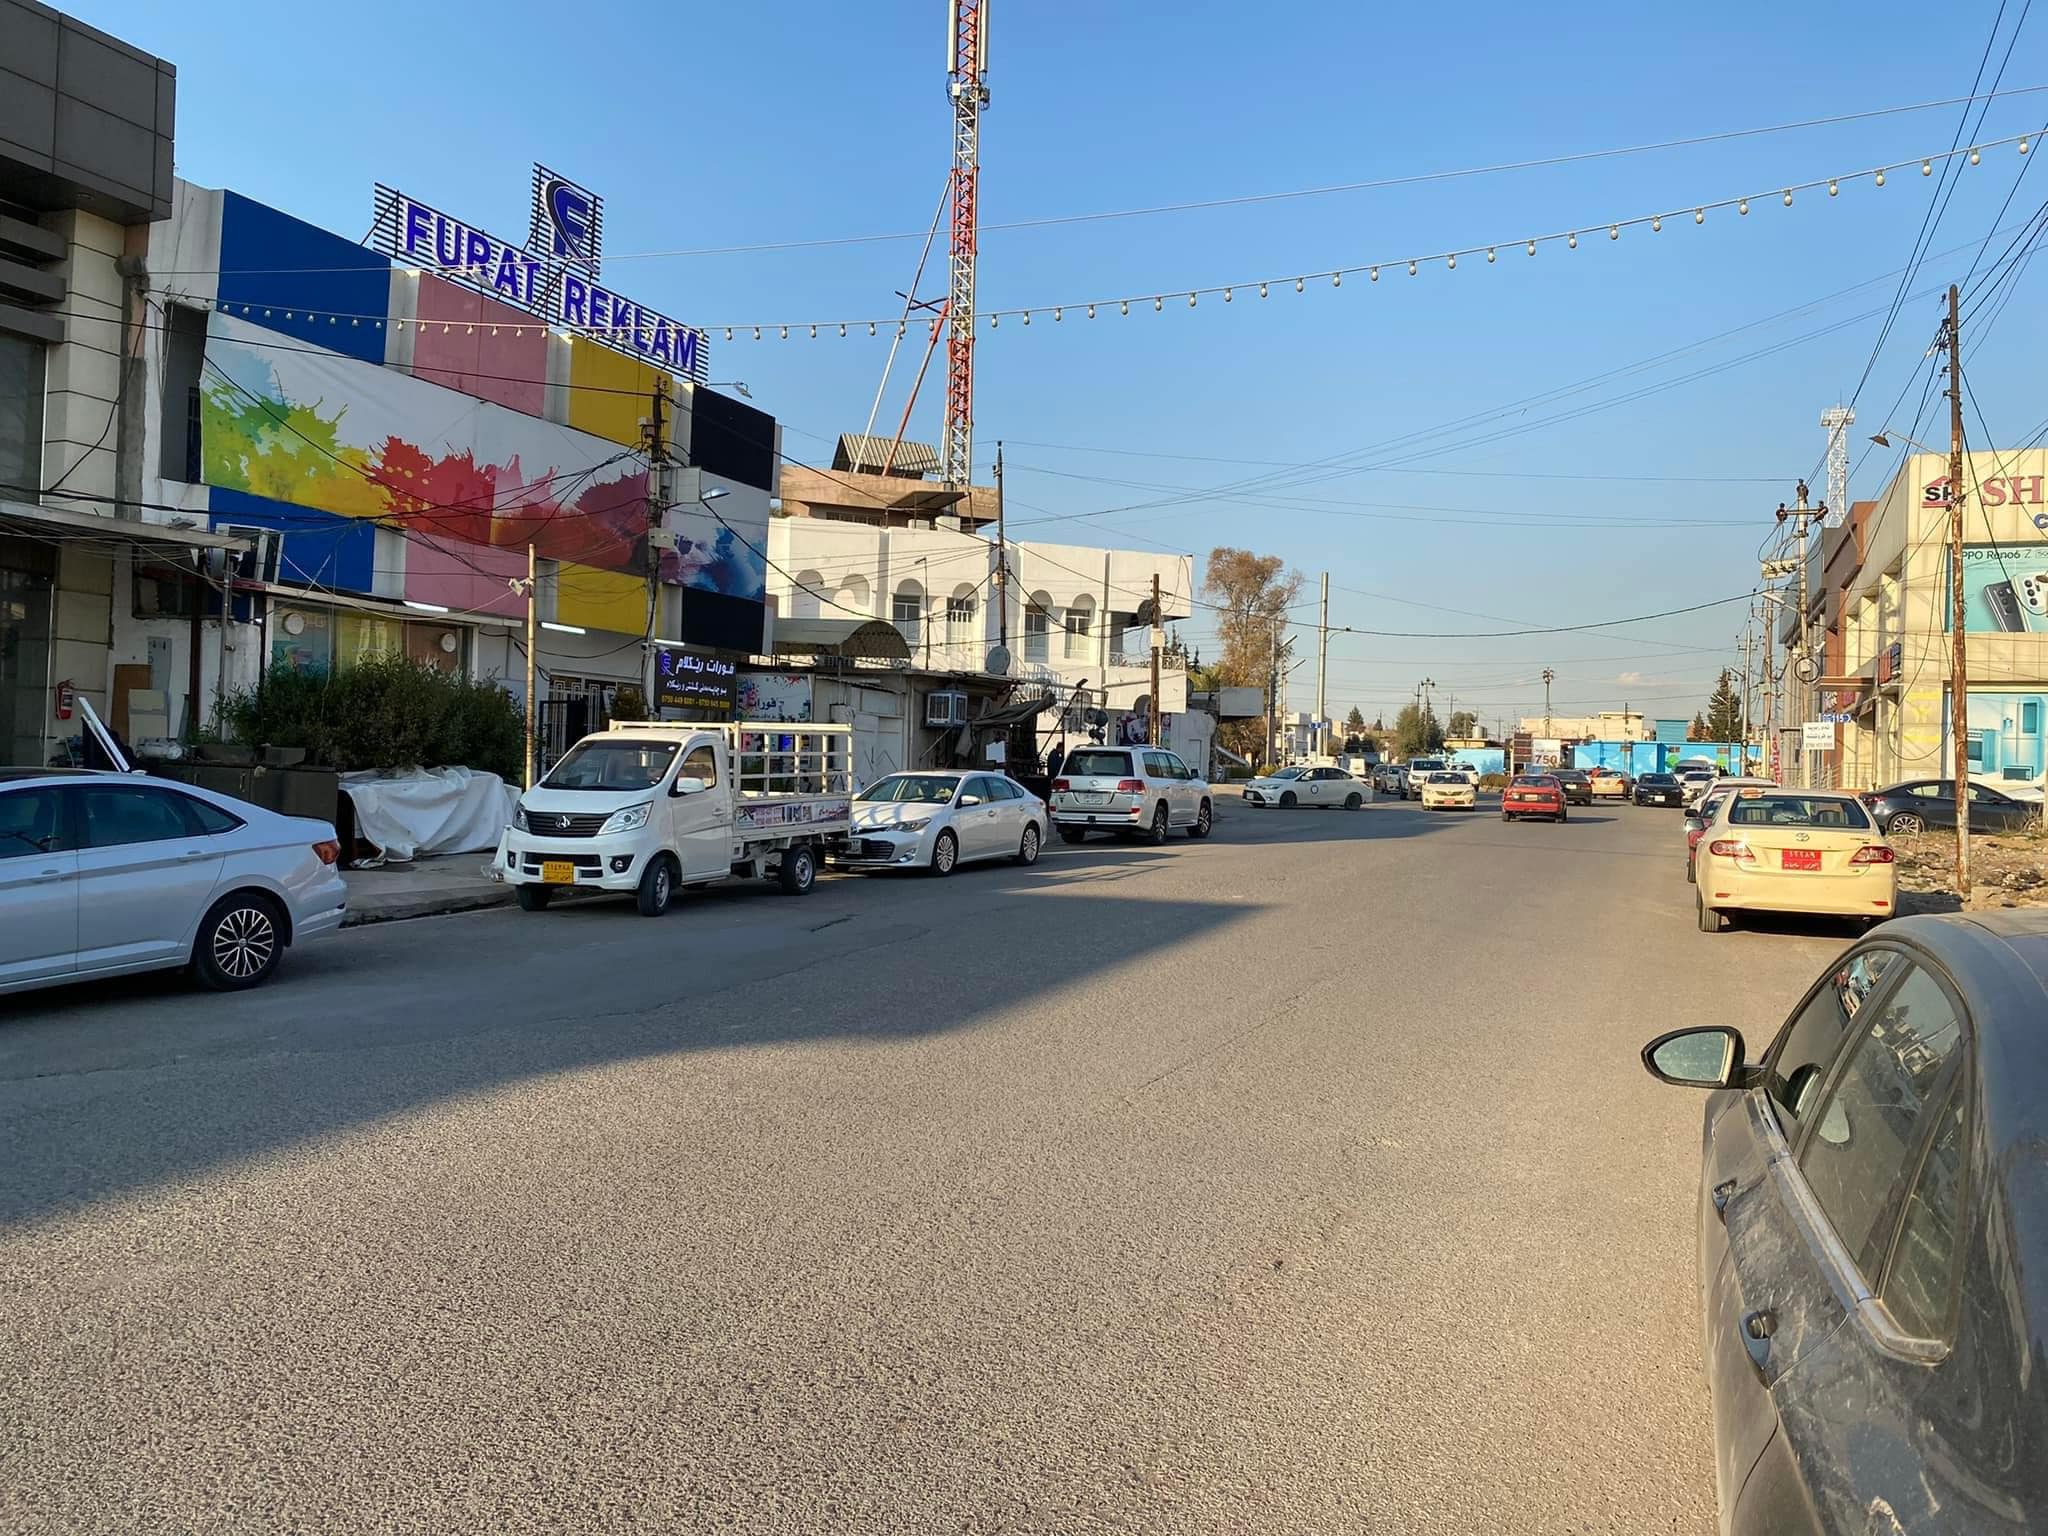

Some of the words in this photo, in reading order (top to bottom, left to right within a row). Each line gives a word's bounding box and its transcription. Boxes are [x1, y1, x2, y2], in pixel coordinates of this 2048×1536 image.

[405, 202, 541, 304] FURAT
[563, 272, 698, 372] REKLAM
[1962, 551, 1983, 560] PPO
[1535, 754, 1558, 765] 750
